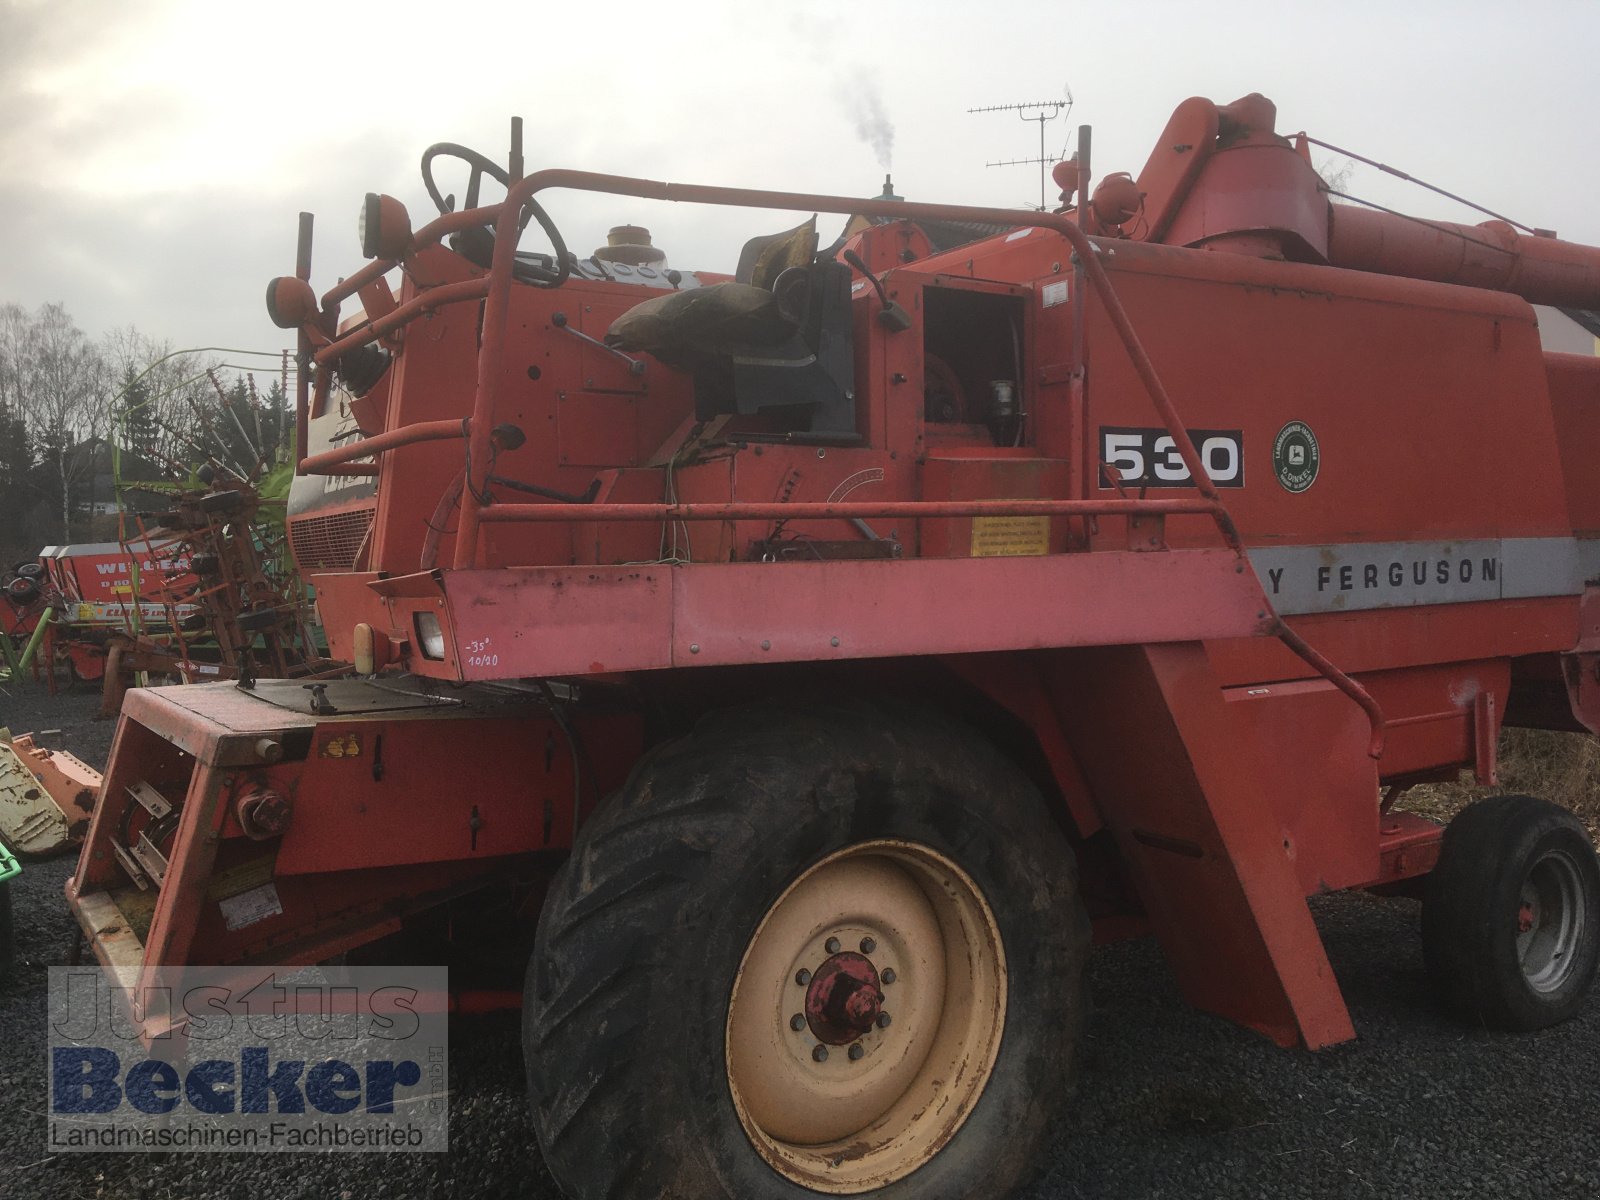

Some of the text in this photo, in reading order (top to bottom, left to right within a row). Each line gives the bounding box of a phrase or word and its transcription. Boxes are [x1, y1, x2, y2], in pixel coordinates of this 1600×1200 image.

[1105, 433, 1239, 481] 530
[96, 559, 190, 574] WEGER
[1318, 557, 1497, 591] FERGUSON
